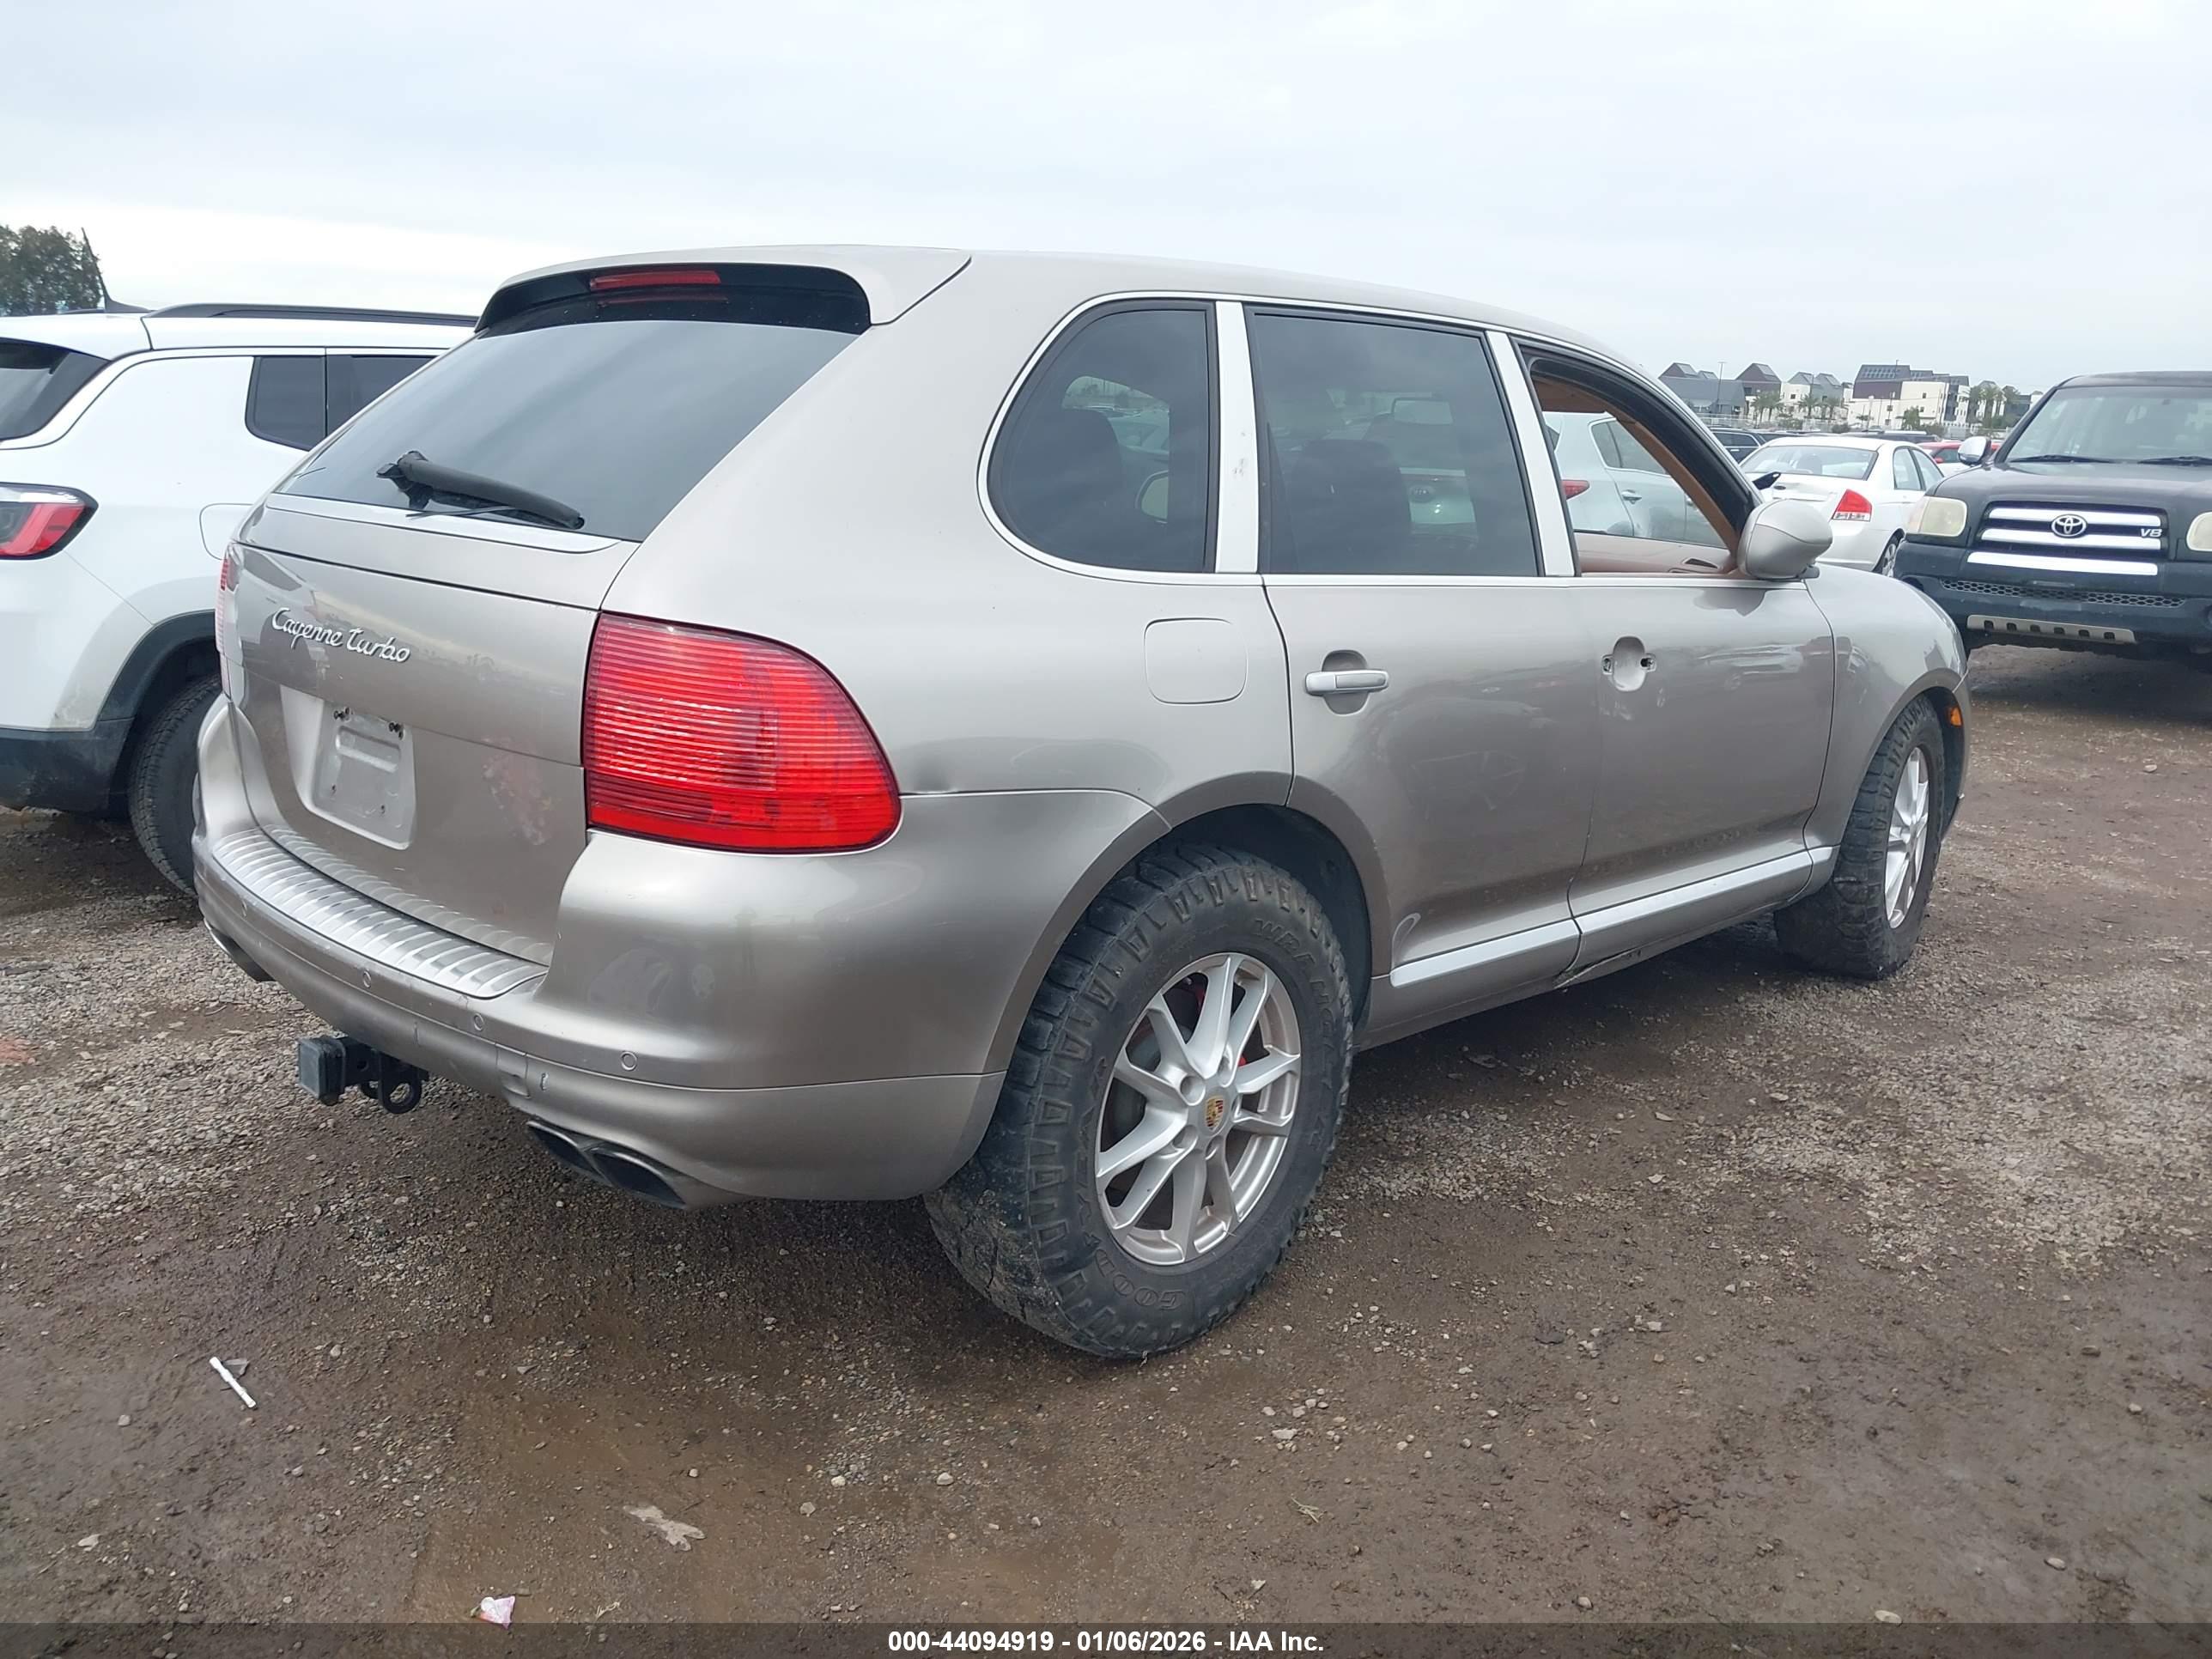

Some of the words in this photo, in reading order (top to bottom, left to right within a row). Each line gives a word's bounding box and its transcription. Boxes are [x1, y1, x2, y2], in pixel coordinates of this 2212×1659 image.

[2141, 528, 2162, 538] V8
[271, 607, 343, 649] Cayenne
[346, 628, 411, 663] Turbo
